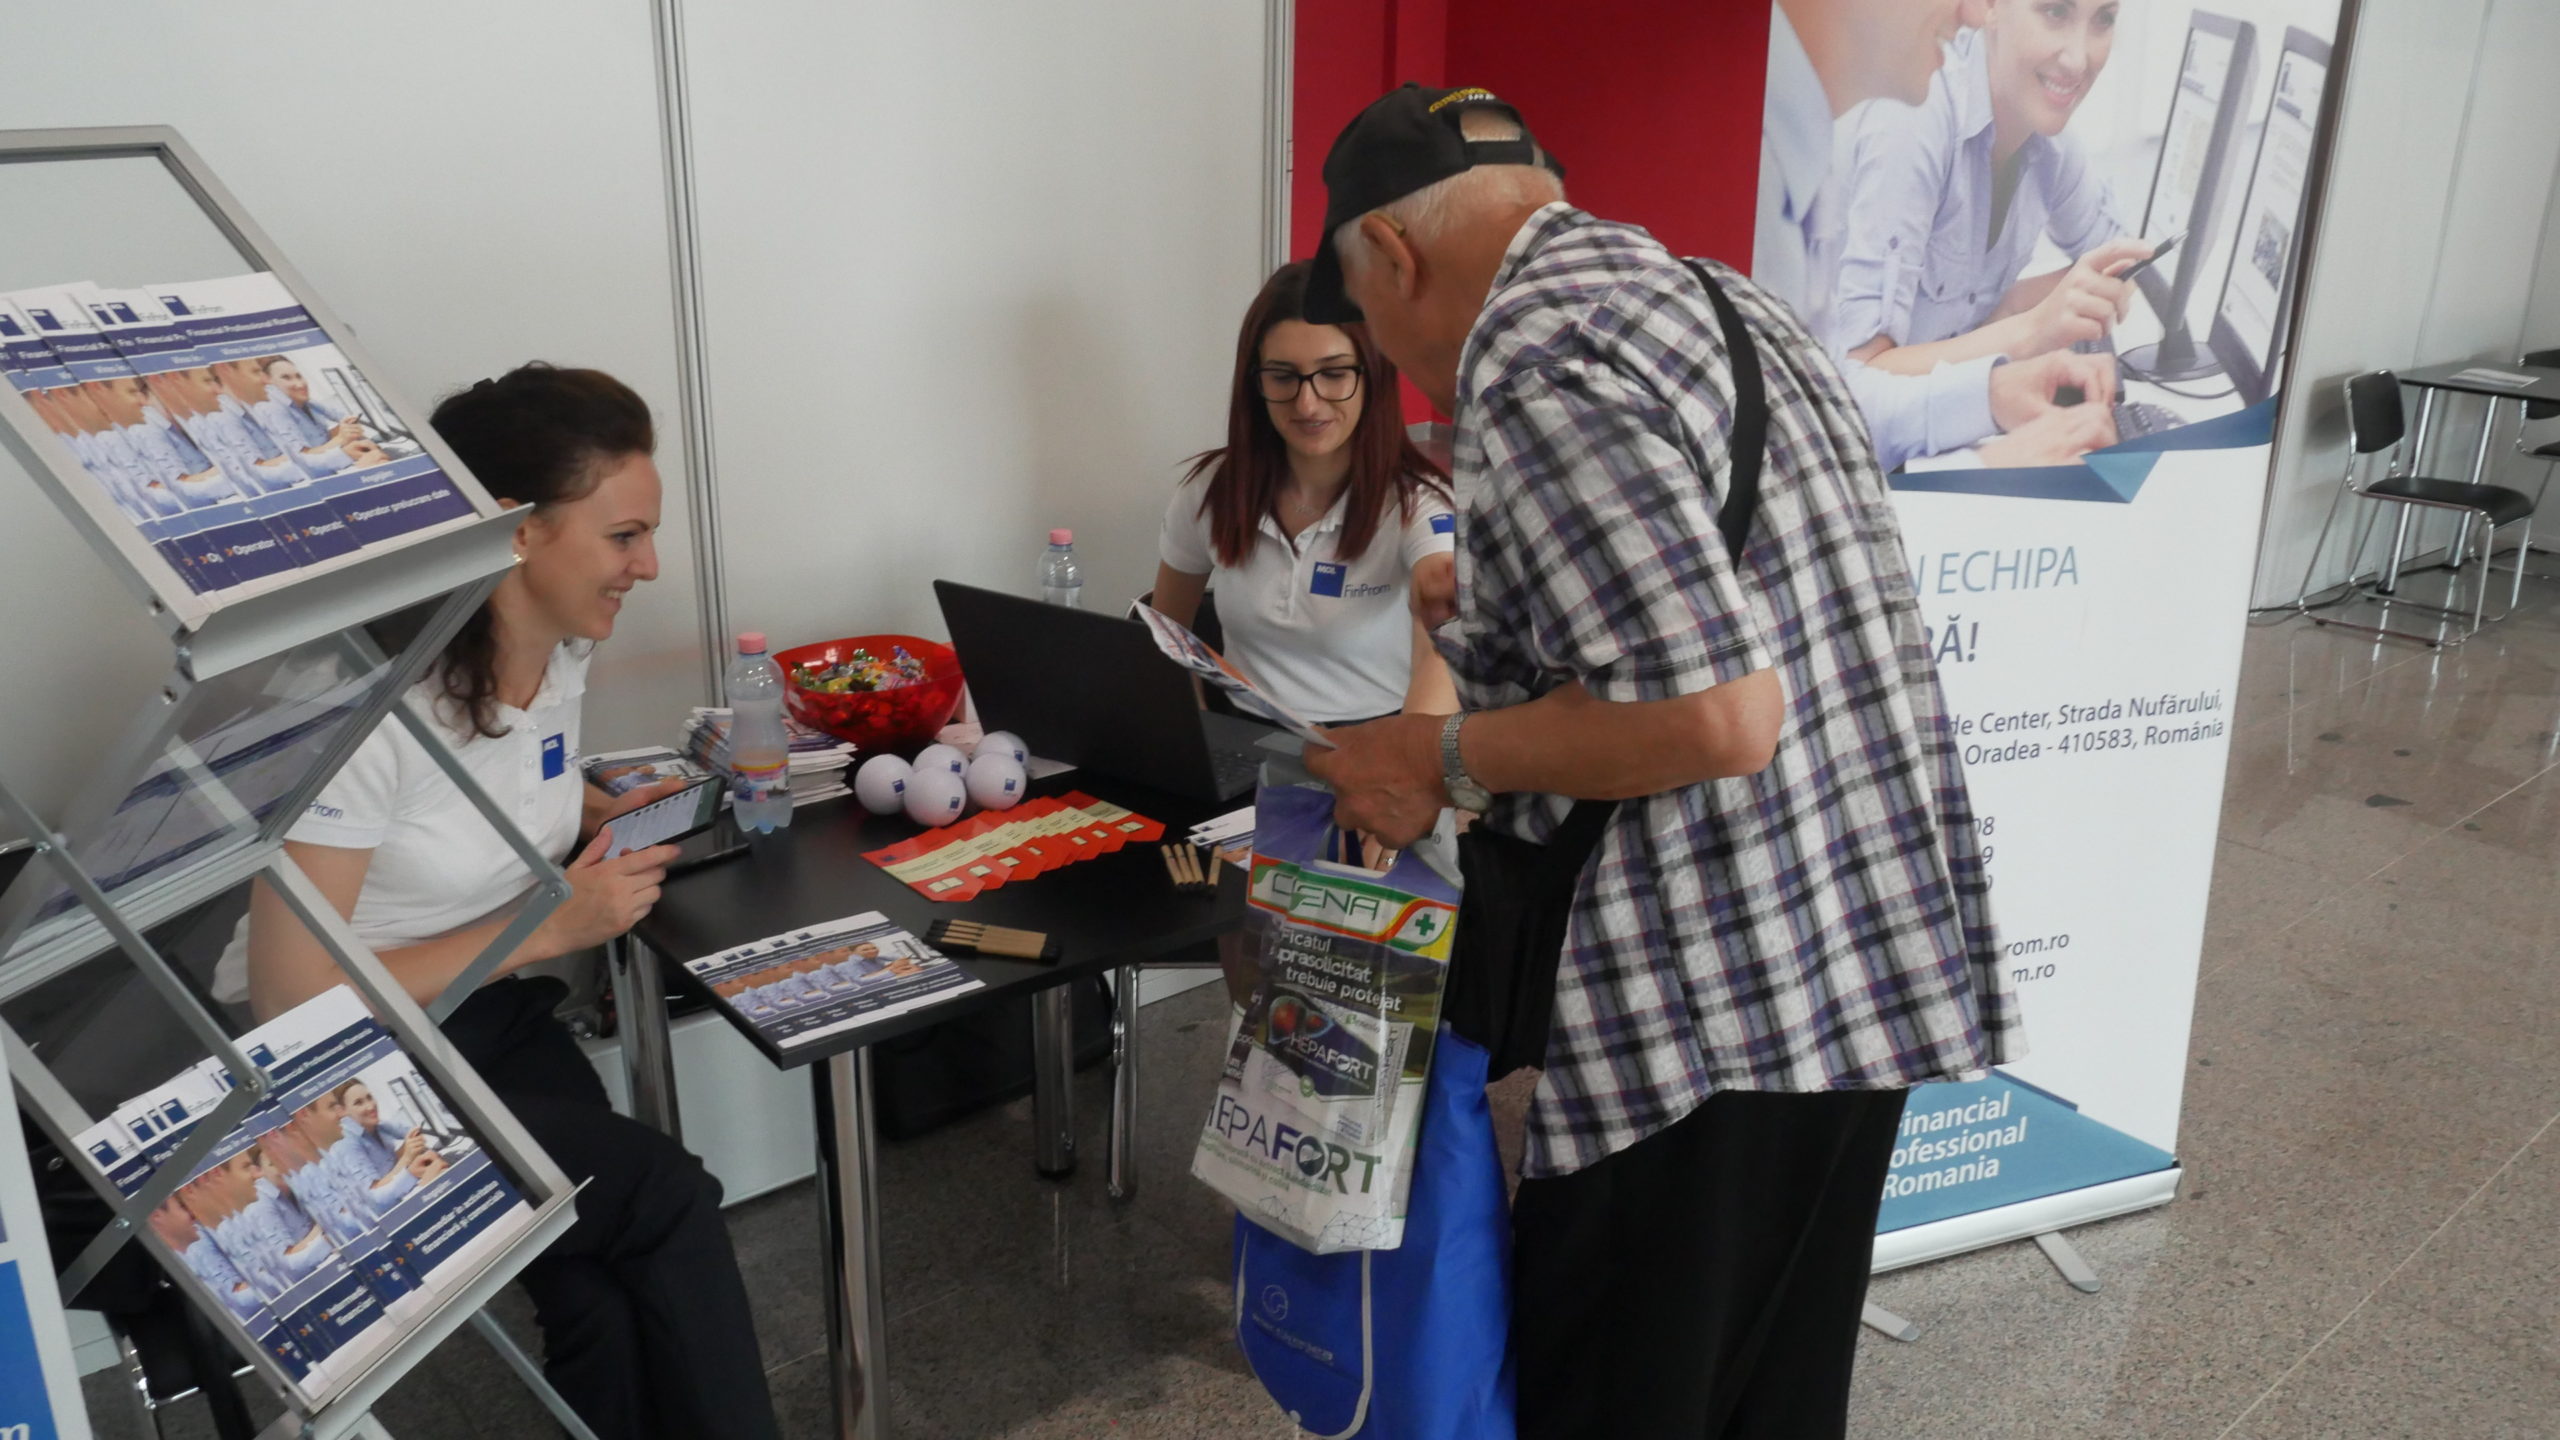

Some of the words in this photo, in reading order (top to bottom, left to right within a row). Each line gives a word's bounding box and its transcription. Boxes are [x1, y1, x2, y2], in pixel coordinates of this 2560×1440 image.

[1937, 545, 2078, 595] ECHIPA
[1980, 711, 2052, 733] Center,
[2058, 699, 2122, 726] Strada
[2128, 688, 2224, 718] Nufărului,
[1964, 739, 2041, 766] Oradea
[2058, 727, 2139, 755] 410583,
[2144, 719, 2225, 747] România
[1285, 965, 1338, 992] trebuie
[1340, 983, 1402, 1012] protejat
[1289, 1032, 1374, 1081] HEPAFORT
[1899, 1090, 2011, 1137] inancial
[1889, 1115, 2028, 1169] ofessional
[1880, 1155, 2000, 1201] Romania
